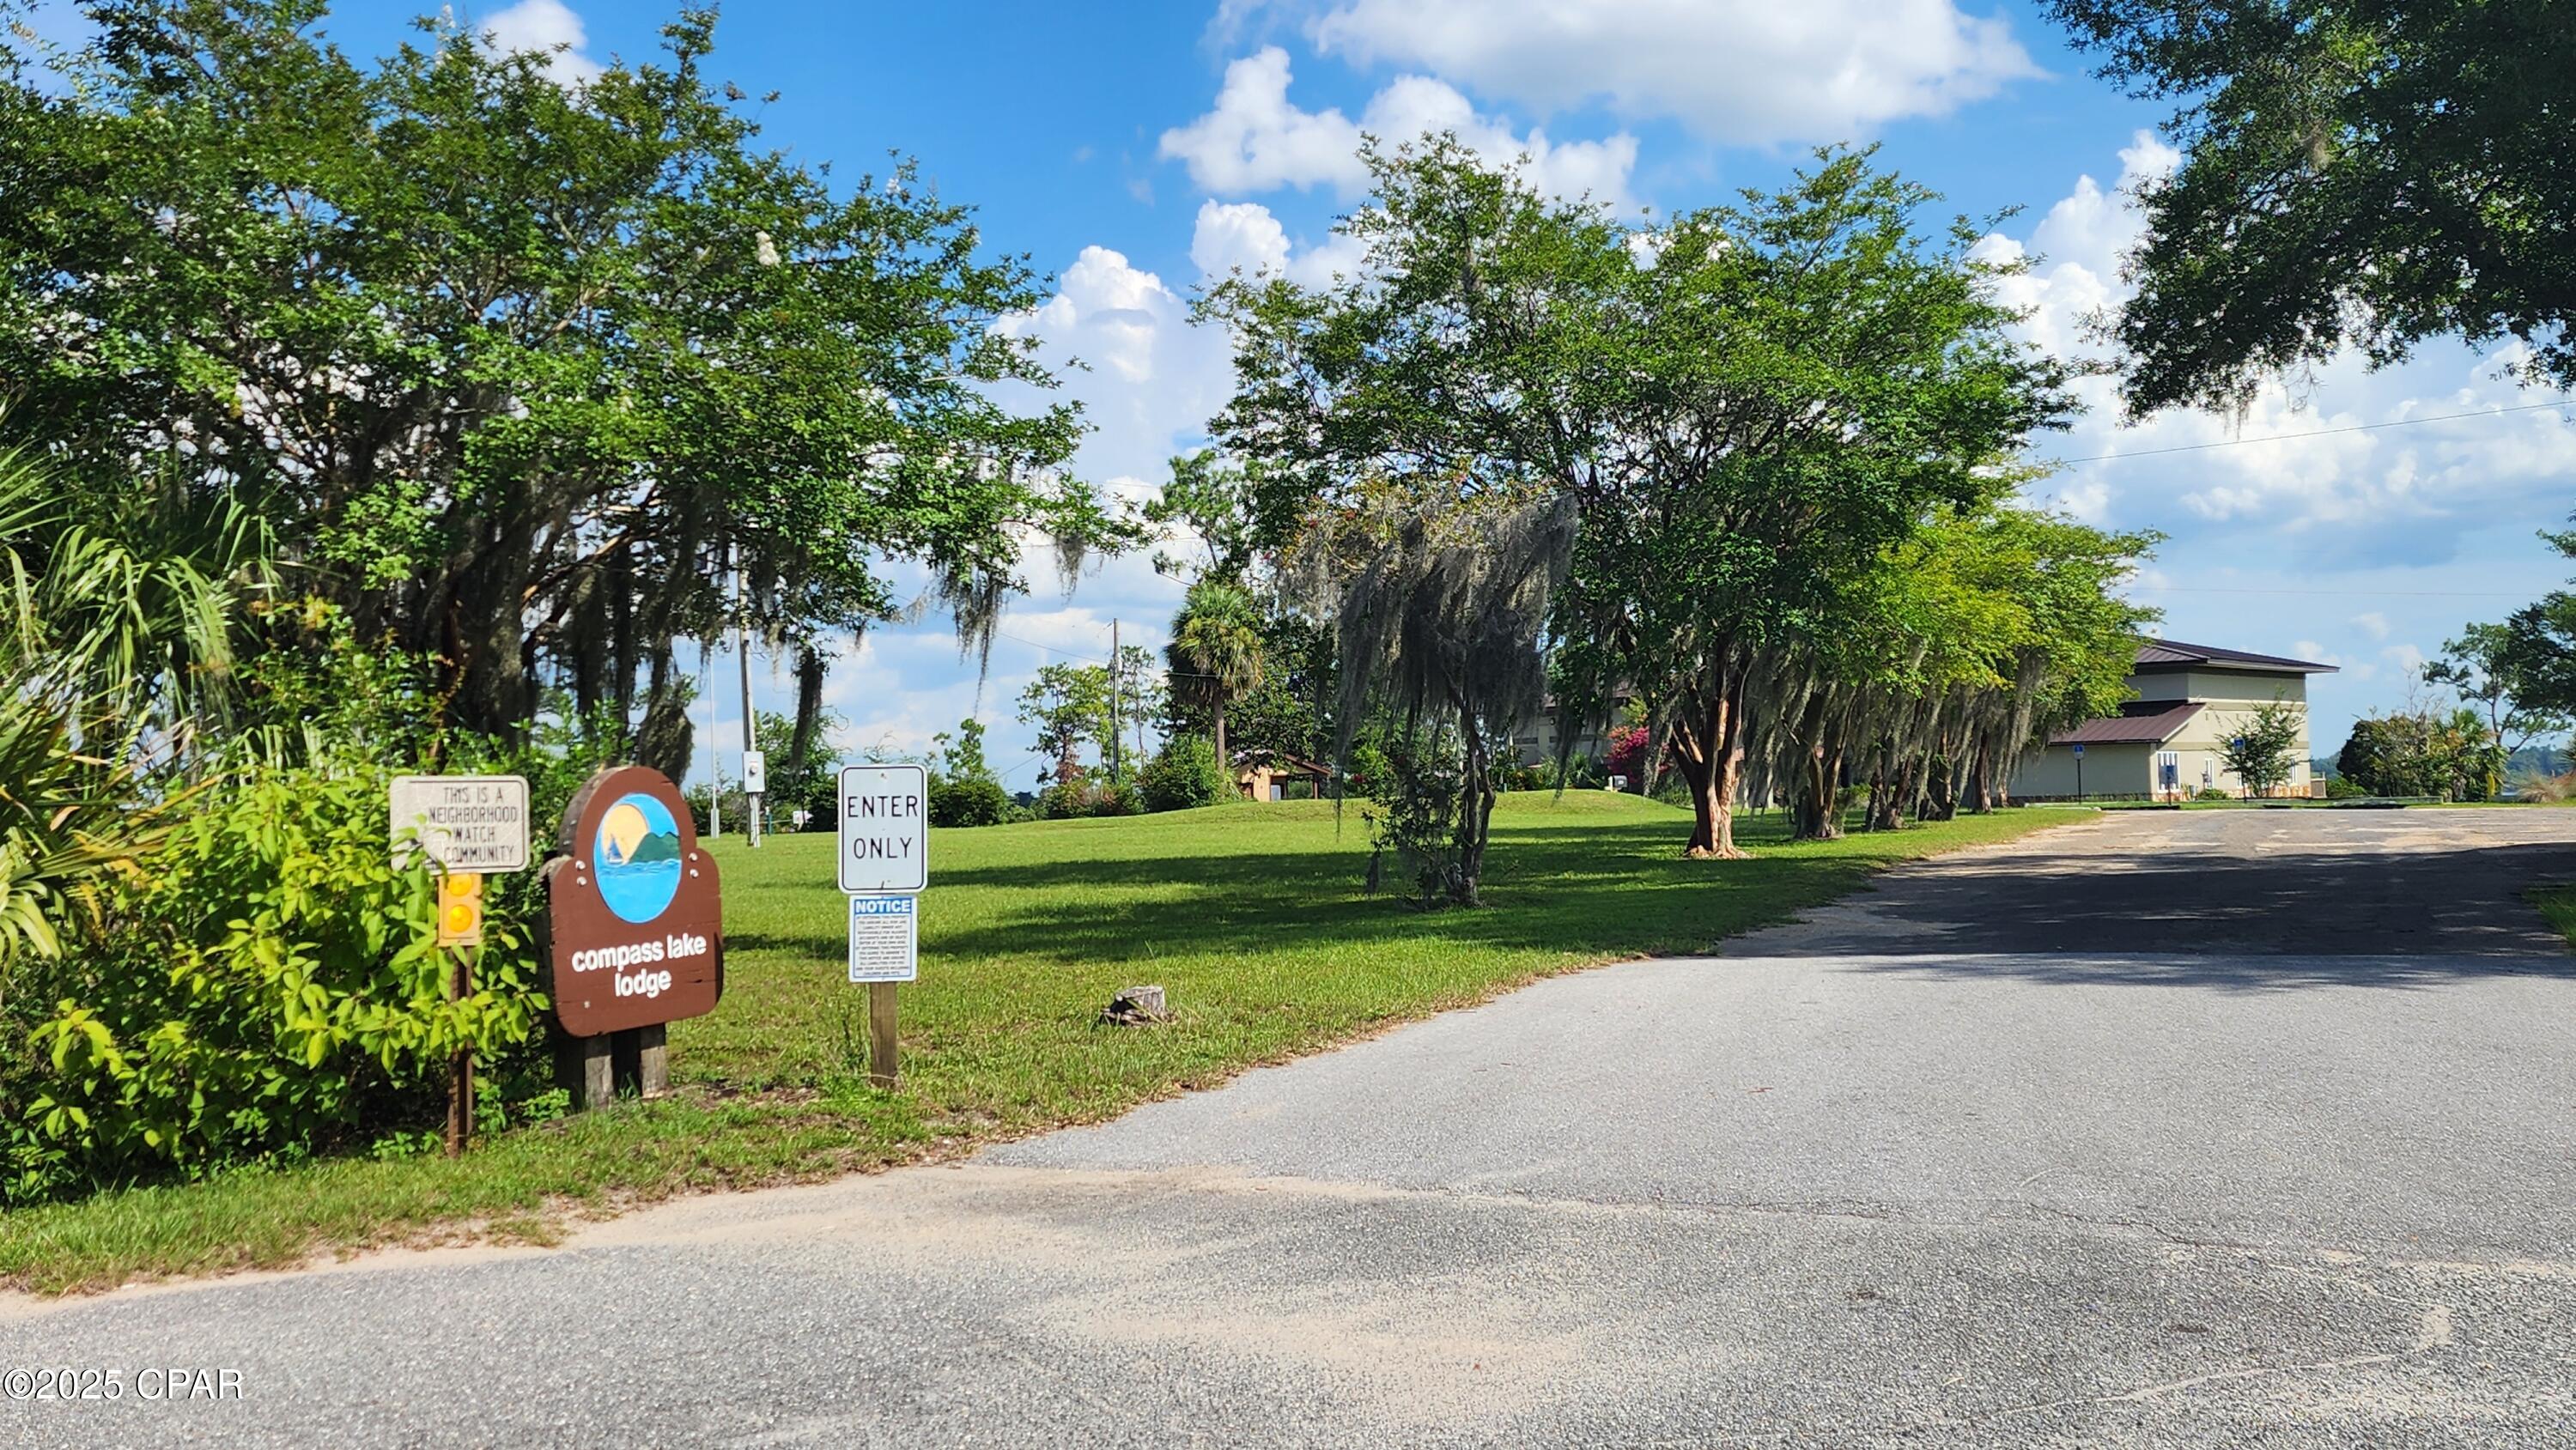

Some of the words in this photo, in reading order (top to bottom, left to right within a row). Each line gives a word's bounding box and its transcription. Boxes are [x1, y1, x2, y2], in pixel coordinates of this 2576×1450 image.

[443, 786, 469, 804] THIS
[477, 786, 488, 804] IS
[495, 787, 503, 803] A
[429, 806, 517, 823] NEIGHBORHOOD
[848, 795, 918, 817] ENTER
[453, 826, 495, 842] WATCH
[443, 845, 514, 863] COMMUNITY
[854, 837, 912, 859] ONLY
[855, 900, 910, 913] NOTICE
[572, 941, 665, 972] compass
[666, 932, 707, 959] lake
[615, 968, 672, 998] lodge
